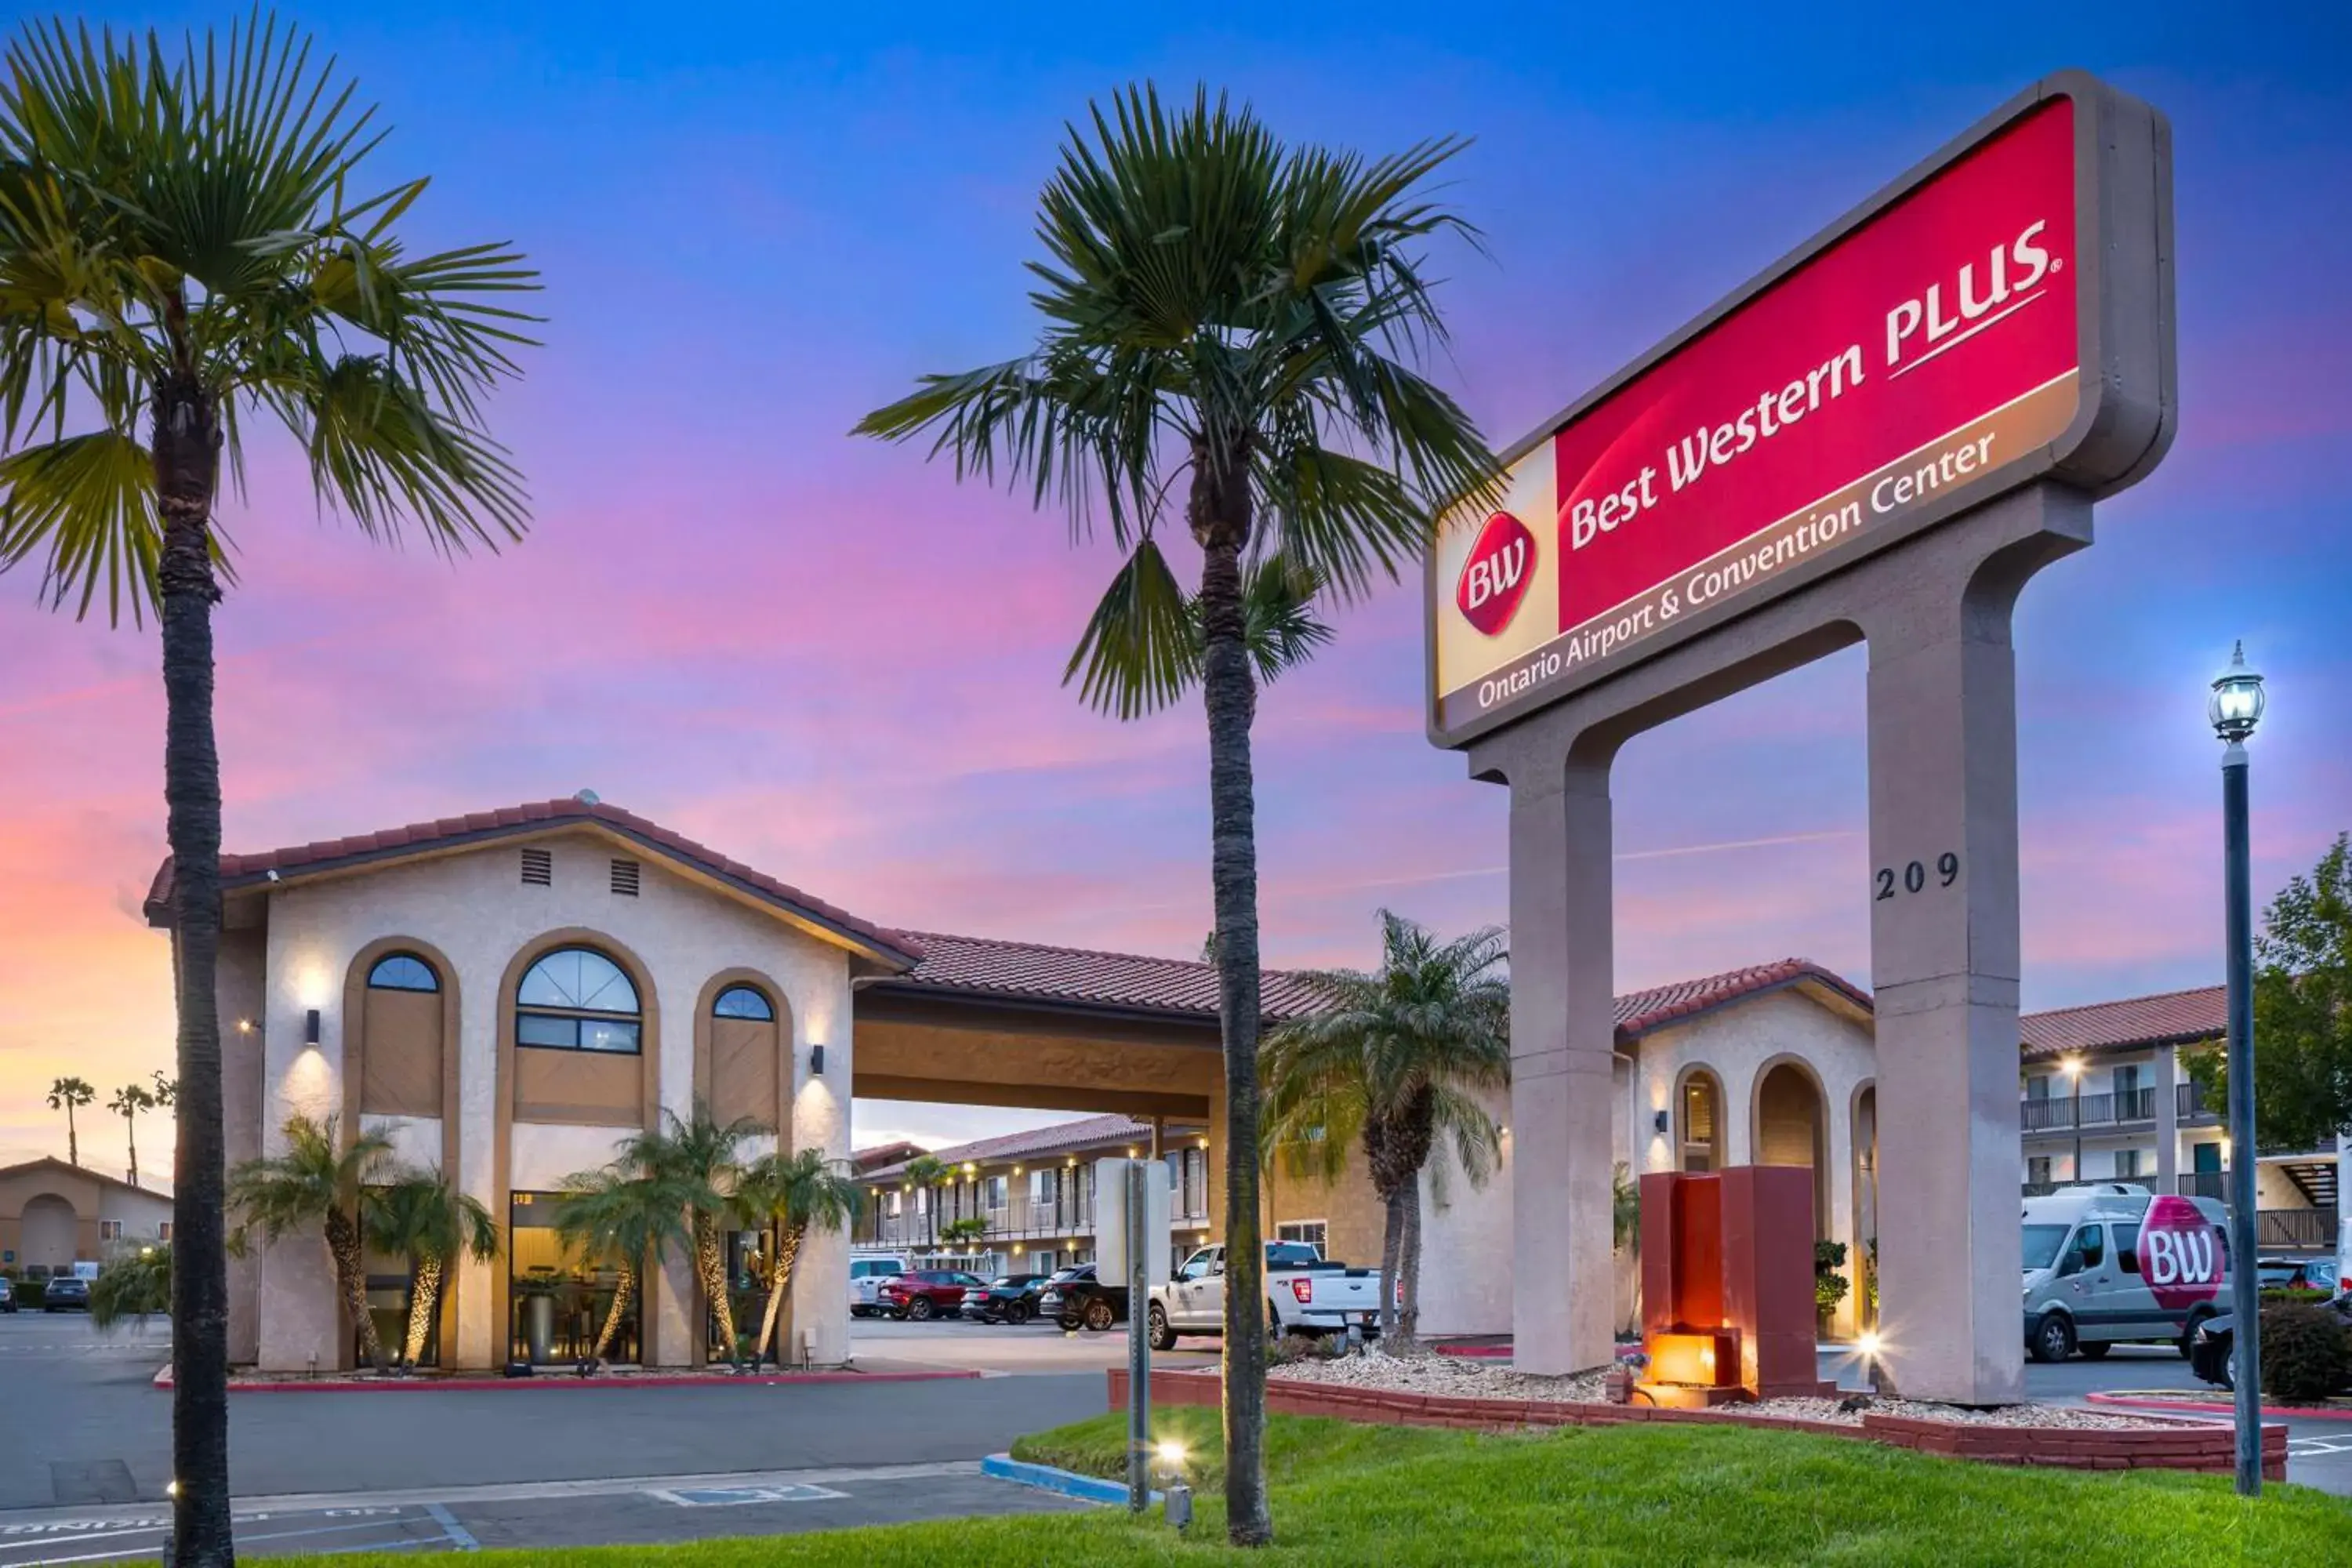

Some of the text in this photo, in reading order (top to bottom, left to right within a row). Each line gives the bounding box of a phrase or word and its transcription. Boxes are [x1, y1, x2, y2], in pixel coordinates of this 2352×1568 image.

[1572, 219, 2049, 550] Best Western PLUS
[1468, 537, 1525, 610] BW
[1478, 432, 1995, 708] Ontario Airport & Convention Center
[1876, 851, 1959, 902] 209
[2148, 1230, 2212, 1283] BW
